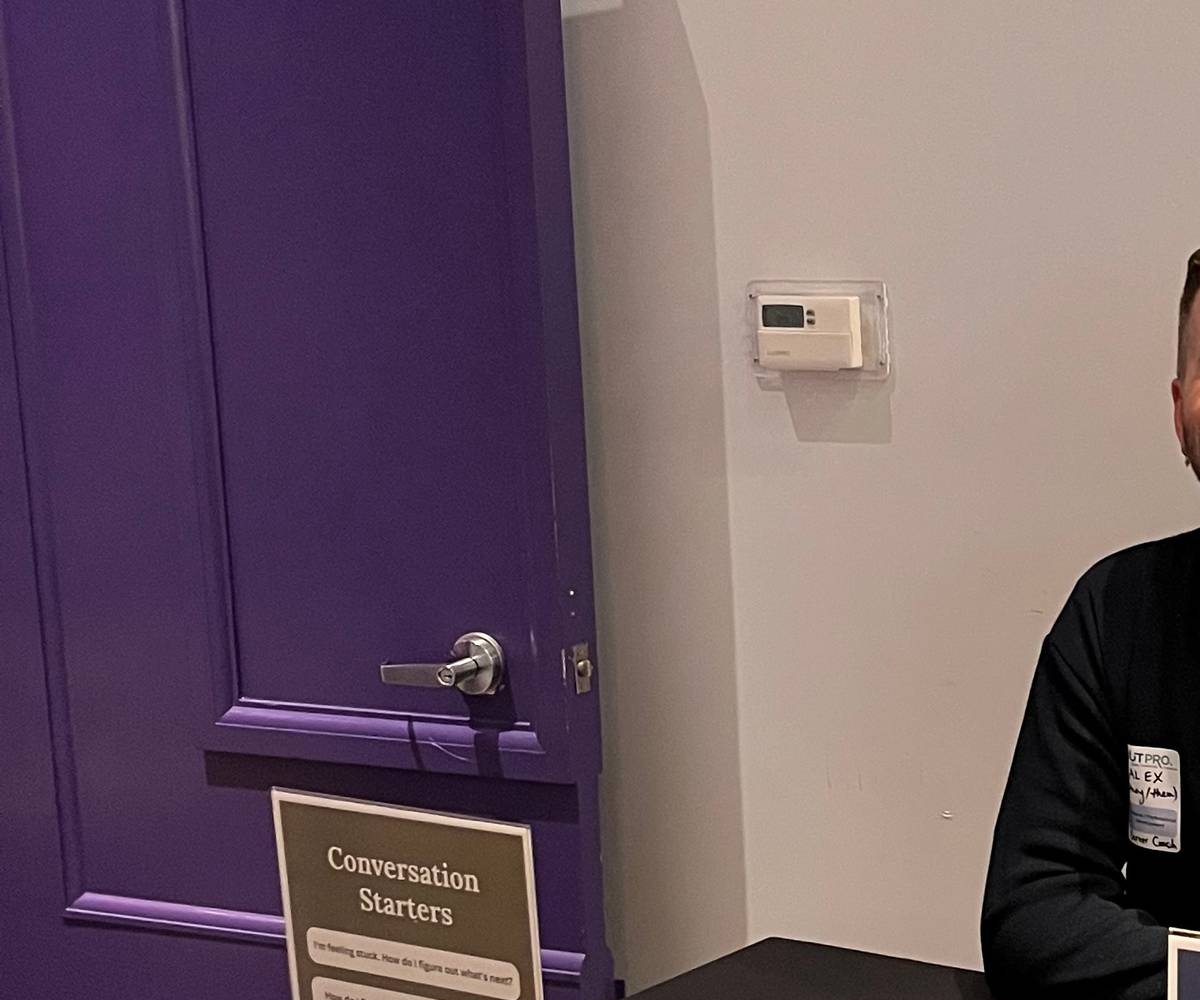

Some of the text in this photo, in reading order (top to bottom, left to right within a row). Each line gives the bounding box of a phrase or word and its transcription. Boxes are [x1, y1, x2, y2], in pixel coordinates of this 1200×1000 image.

[1129, 751, 1173, 768] UTPRO.
[327, 846, 480, 893] Conversation
[359, 887, 454, 925] Starters
[328, 943, 355, 958] feeling
[382, 953, 400, 964] How
[402, 958, 412, 967] do
[419, 960, 443, 972] figure
[444, 967, 459, 976] out
[490, 975, 513, 985] next?
